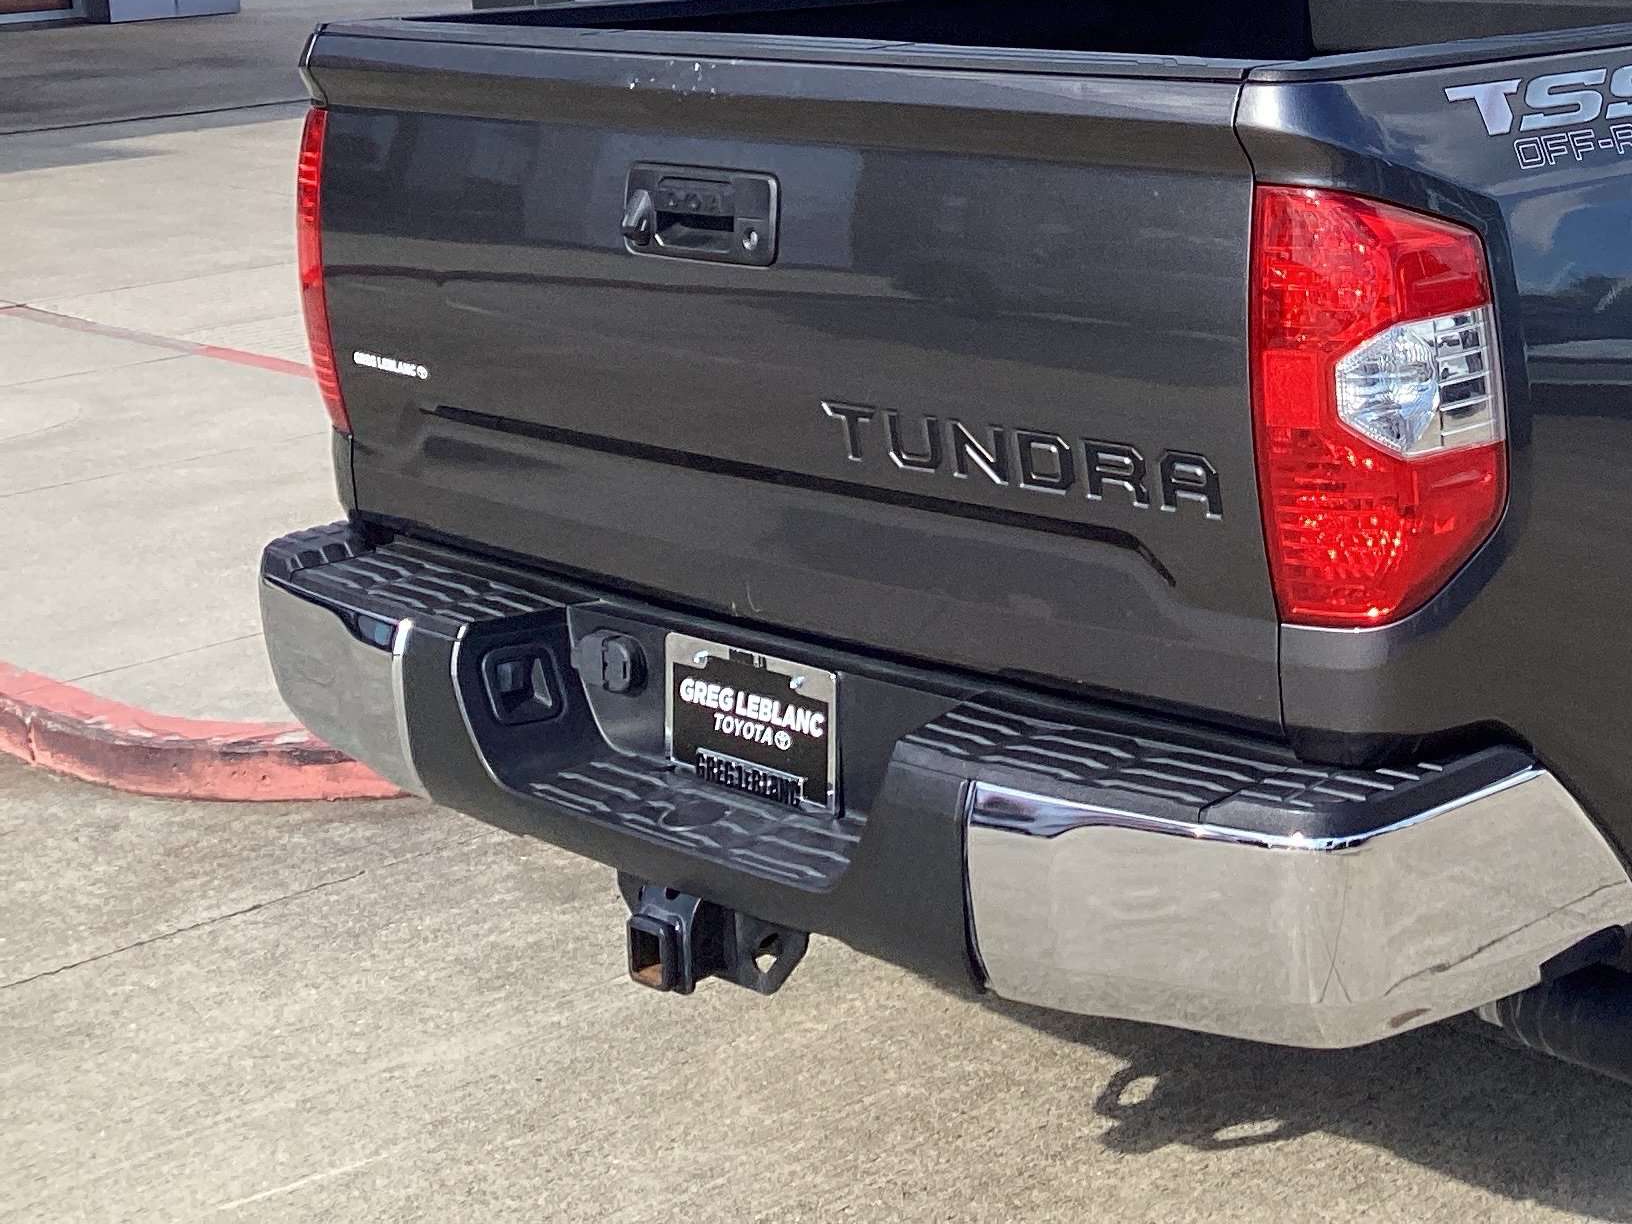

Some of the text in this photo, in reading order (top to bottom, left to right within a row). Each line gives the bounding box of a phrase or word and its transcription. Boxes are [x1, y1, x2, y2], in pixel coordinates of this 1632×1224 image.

[820, 401, 1223, 520] TUNDRA
[679, 678, 826, 739] GREG LEBLANC
[713, 713, 774, 746] TOYOTA
